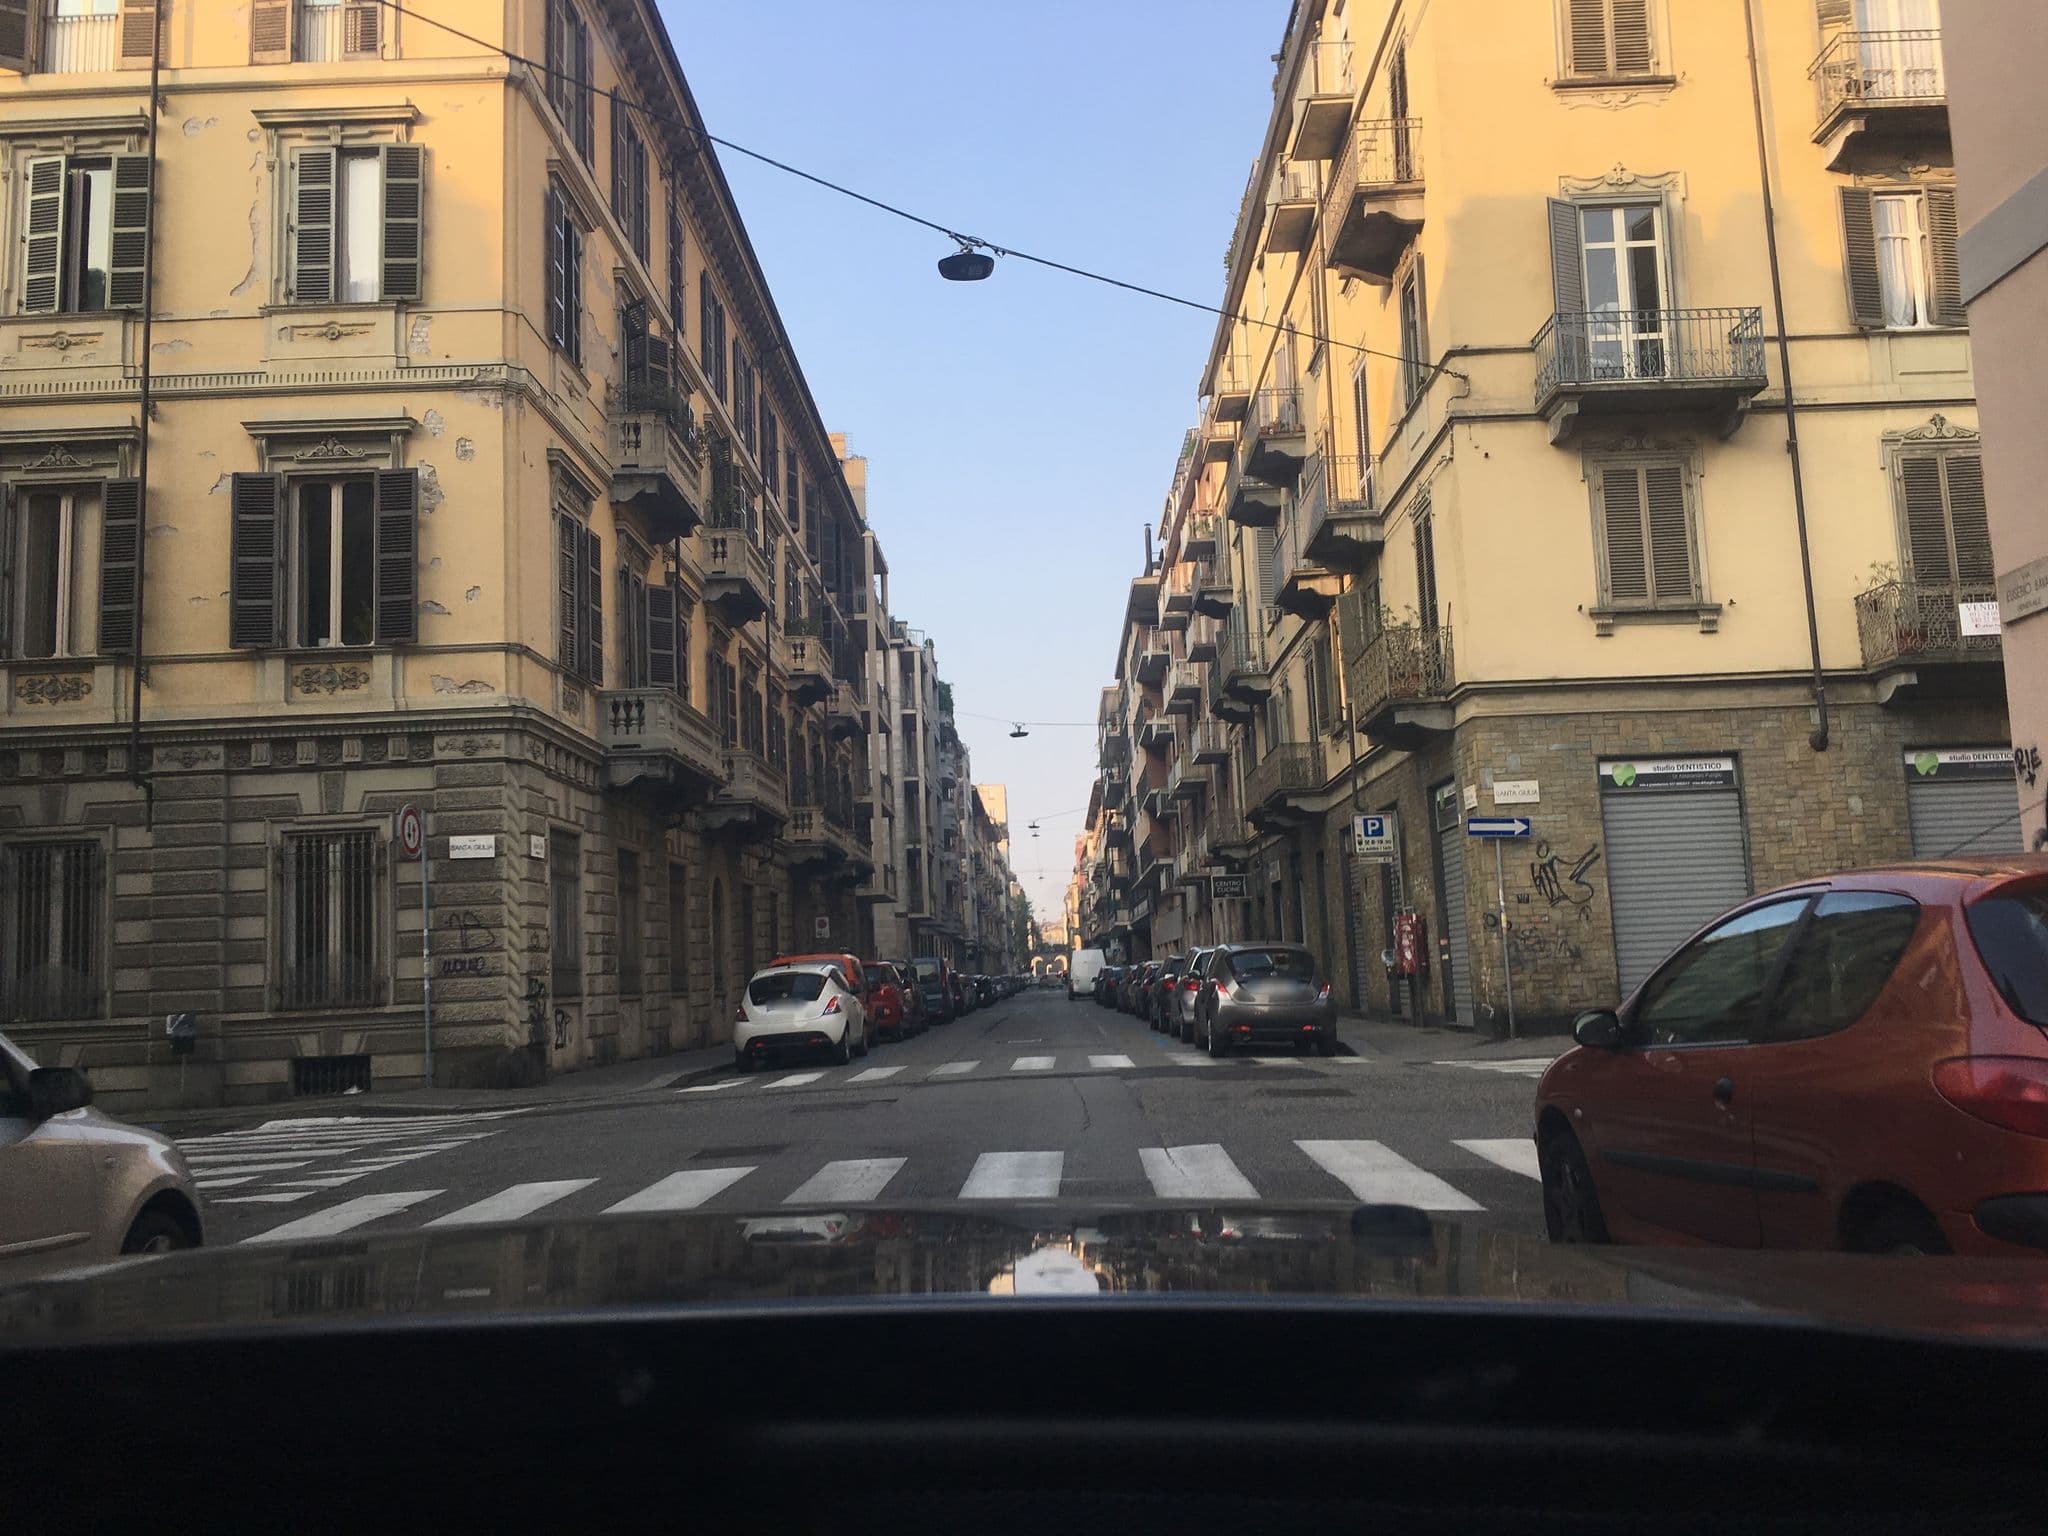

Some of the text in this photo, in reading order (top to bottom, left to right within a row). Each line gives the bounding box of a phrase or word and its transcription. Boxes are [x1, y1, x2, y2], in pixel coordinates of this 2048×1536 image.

[1653, 762, 1721, 772] studio DENTISTICO
[1367, 819, 1380, 835] P
